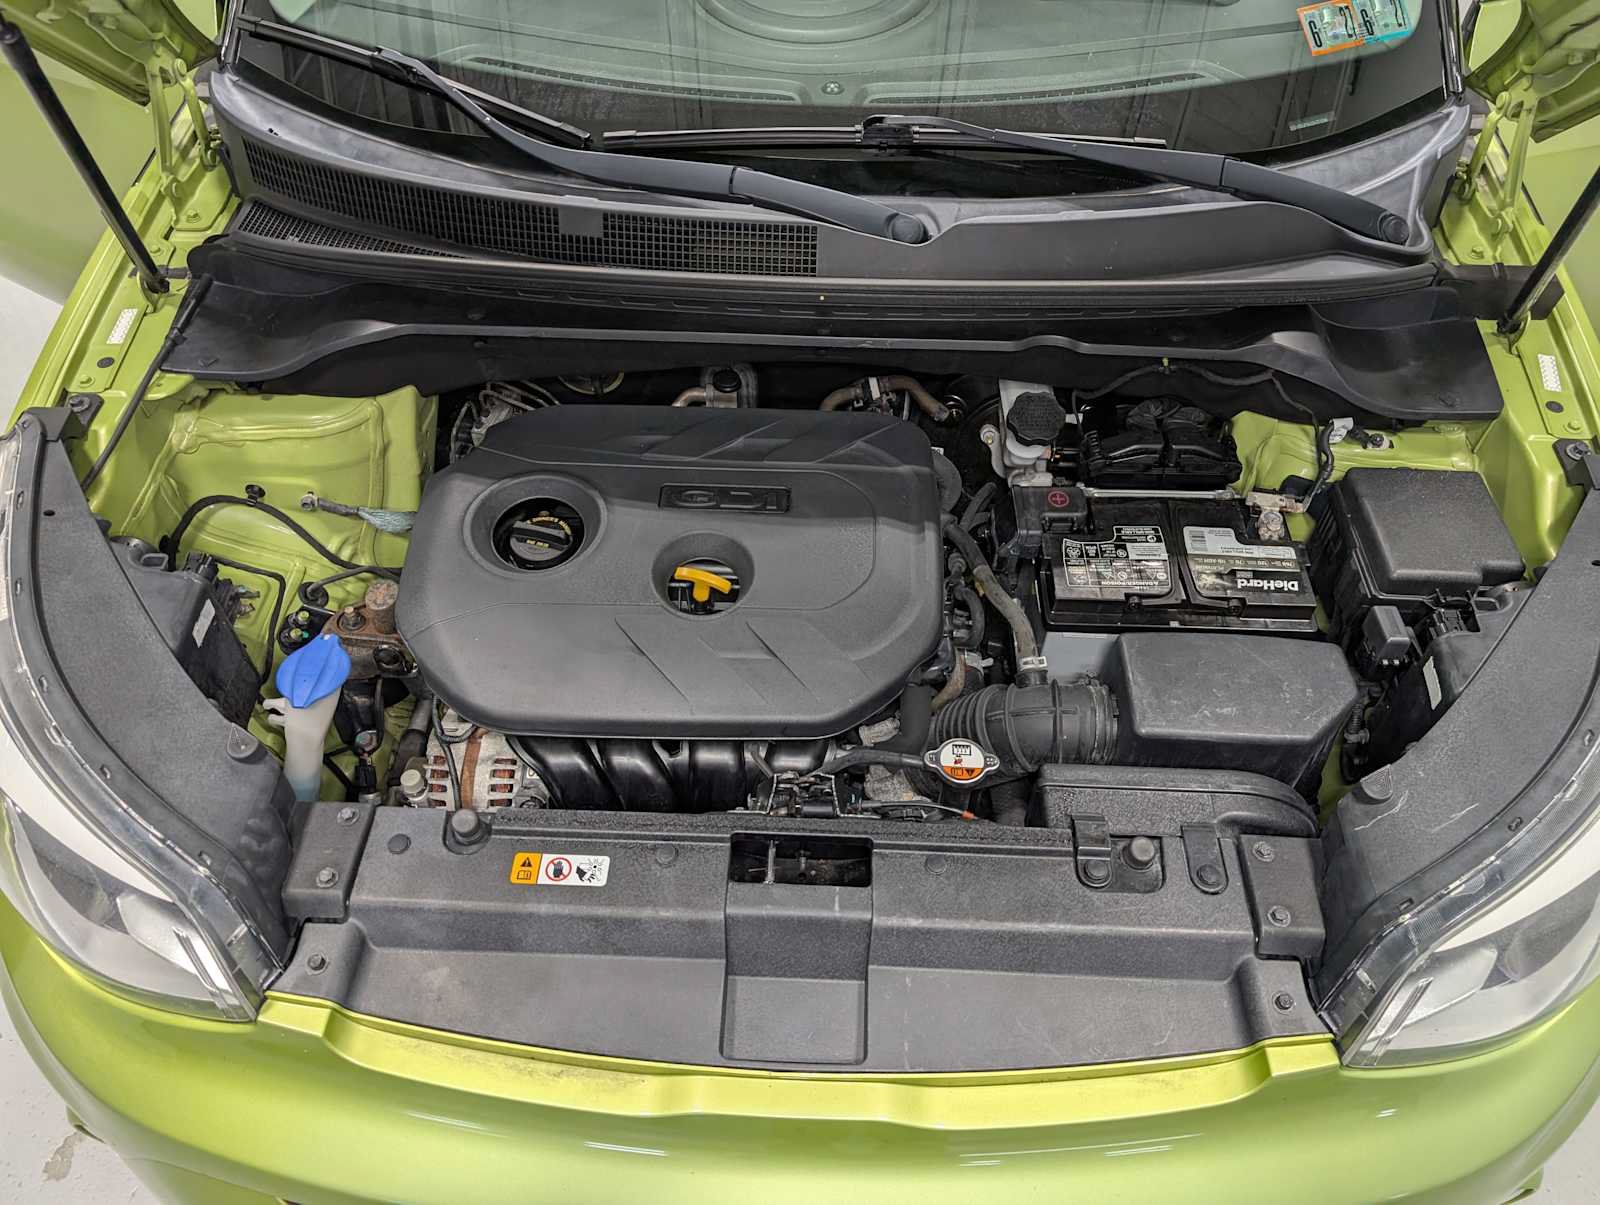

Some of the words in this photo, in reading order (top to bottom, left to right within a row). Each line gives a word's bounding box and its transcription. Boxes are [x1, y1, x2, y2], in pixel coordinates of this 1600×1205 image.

[1308, 20, 1323, 48] 6
[1360, 8, 1375, 36] 6
[1236, 578, 1300, 592] DieHard
